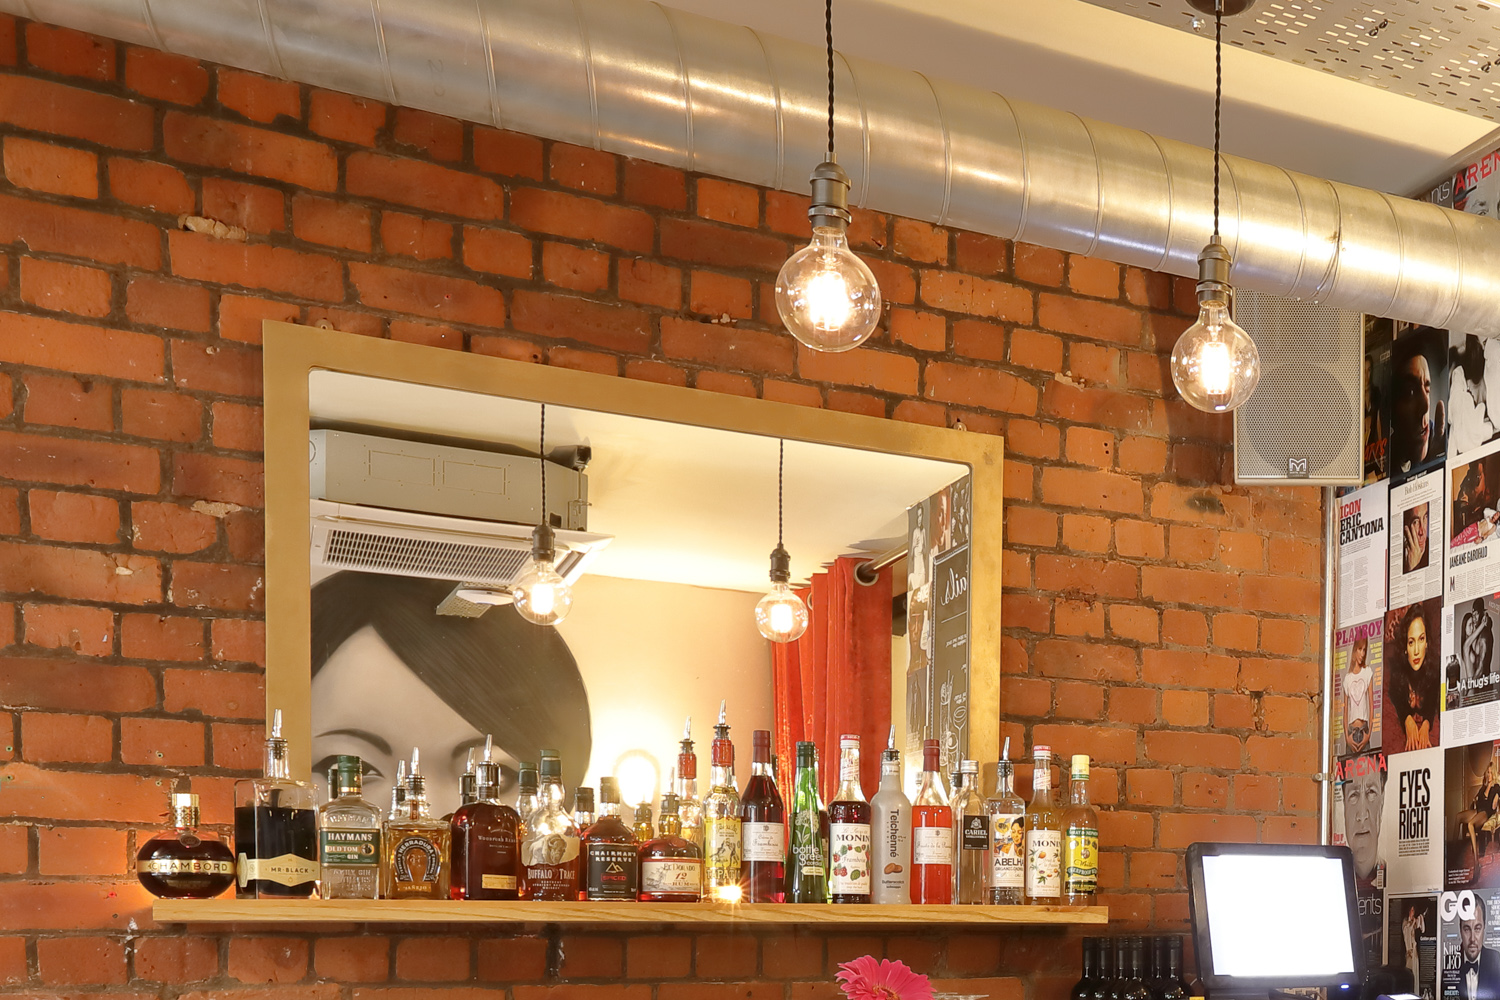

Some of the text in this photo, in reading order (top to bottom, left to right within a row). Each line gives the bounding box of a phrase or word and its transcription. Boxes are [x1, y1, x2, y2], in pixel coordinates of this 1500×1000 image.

[1340, 499, 1362, 517] ICON
[1340, 512, 1361, 533] ERIC
[1340, 517, 1384, 546] CANTONA
[1335, 620, 1383, 647] PLAYBOY
[1335, 753, 1387, 781] ARENA
[1399, 767, 1431, 810] EYES
[1398, 807, 1430, 840] RIGHT
[150, 861, 228, 872] CHAMBORD
[527, 868, 575, 880] BUFFALO TRACE
[1440, 890, 1476, 922] GQ
